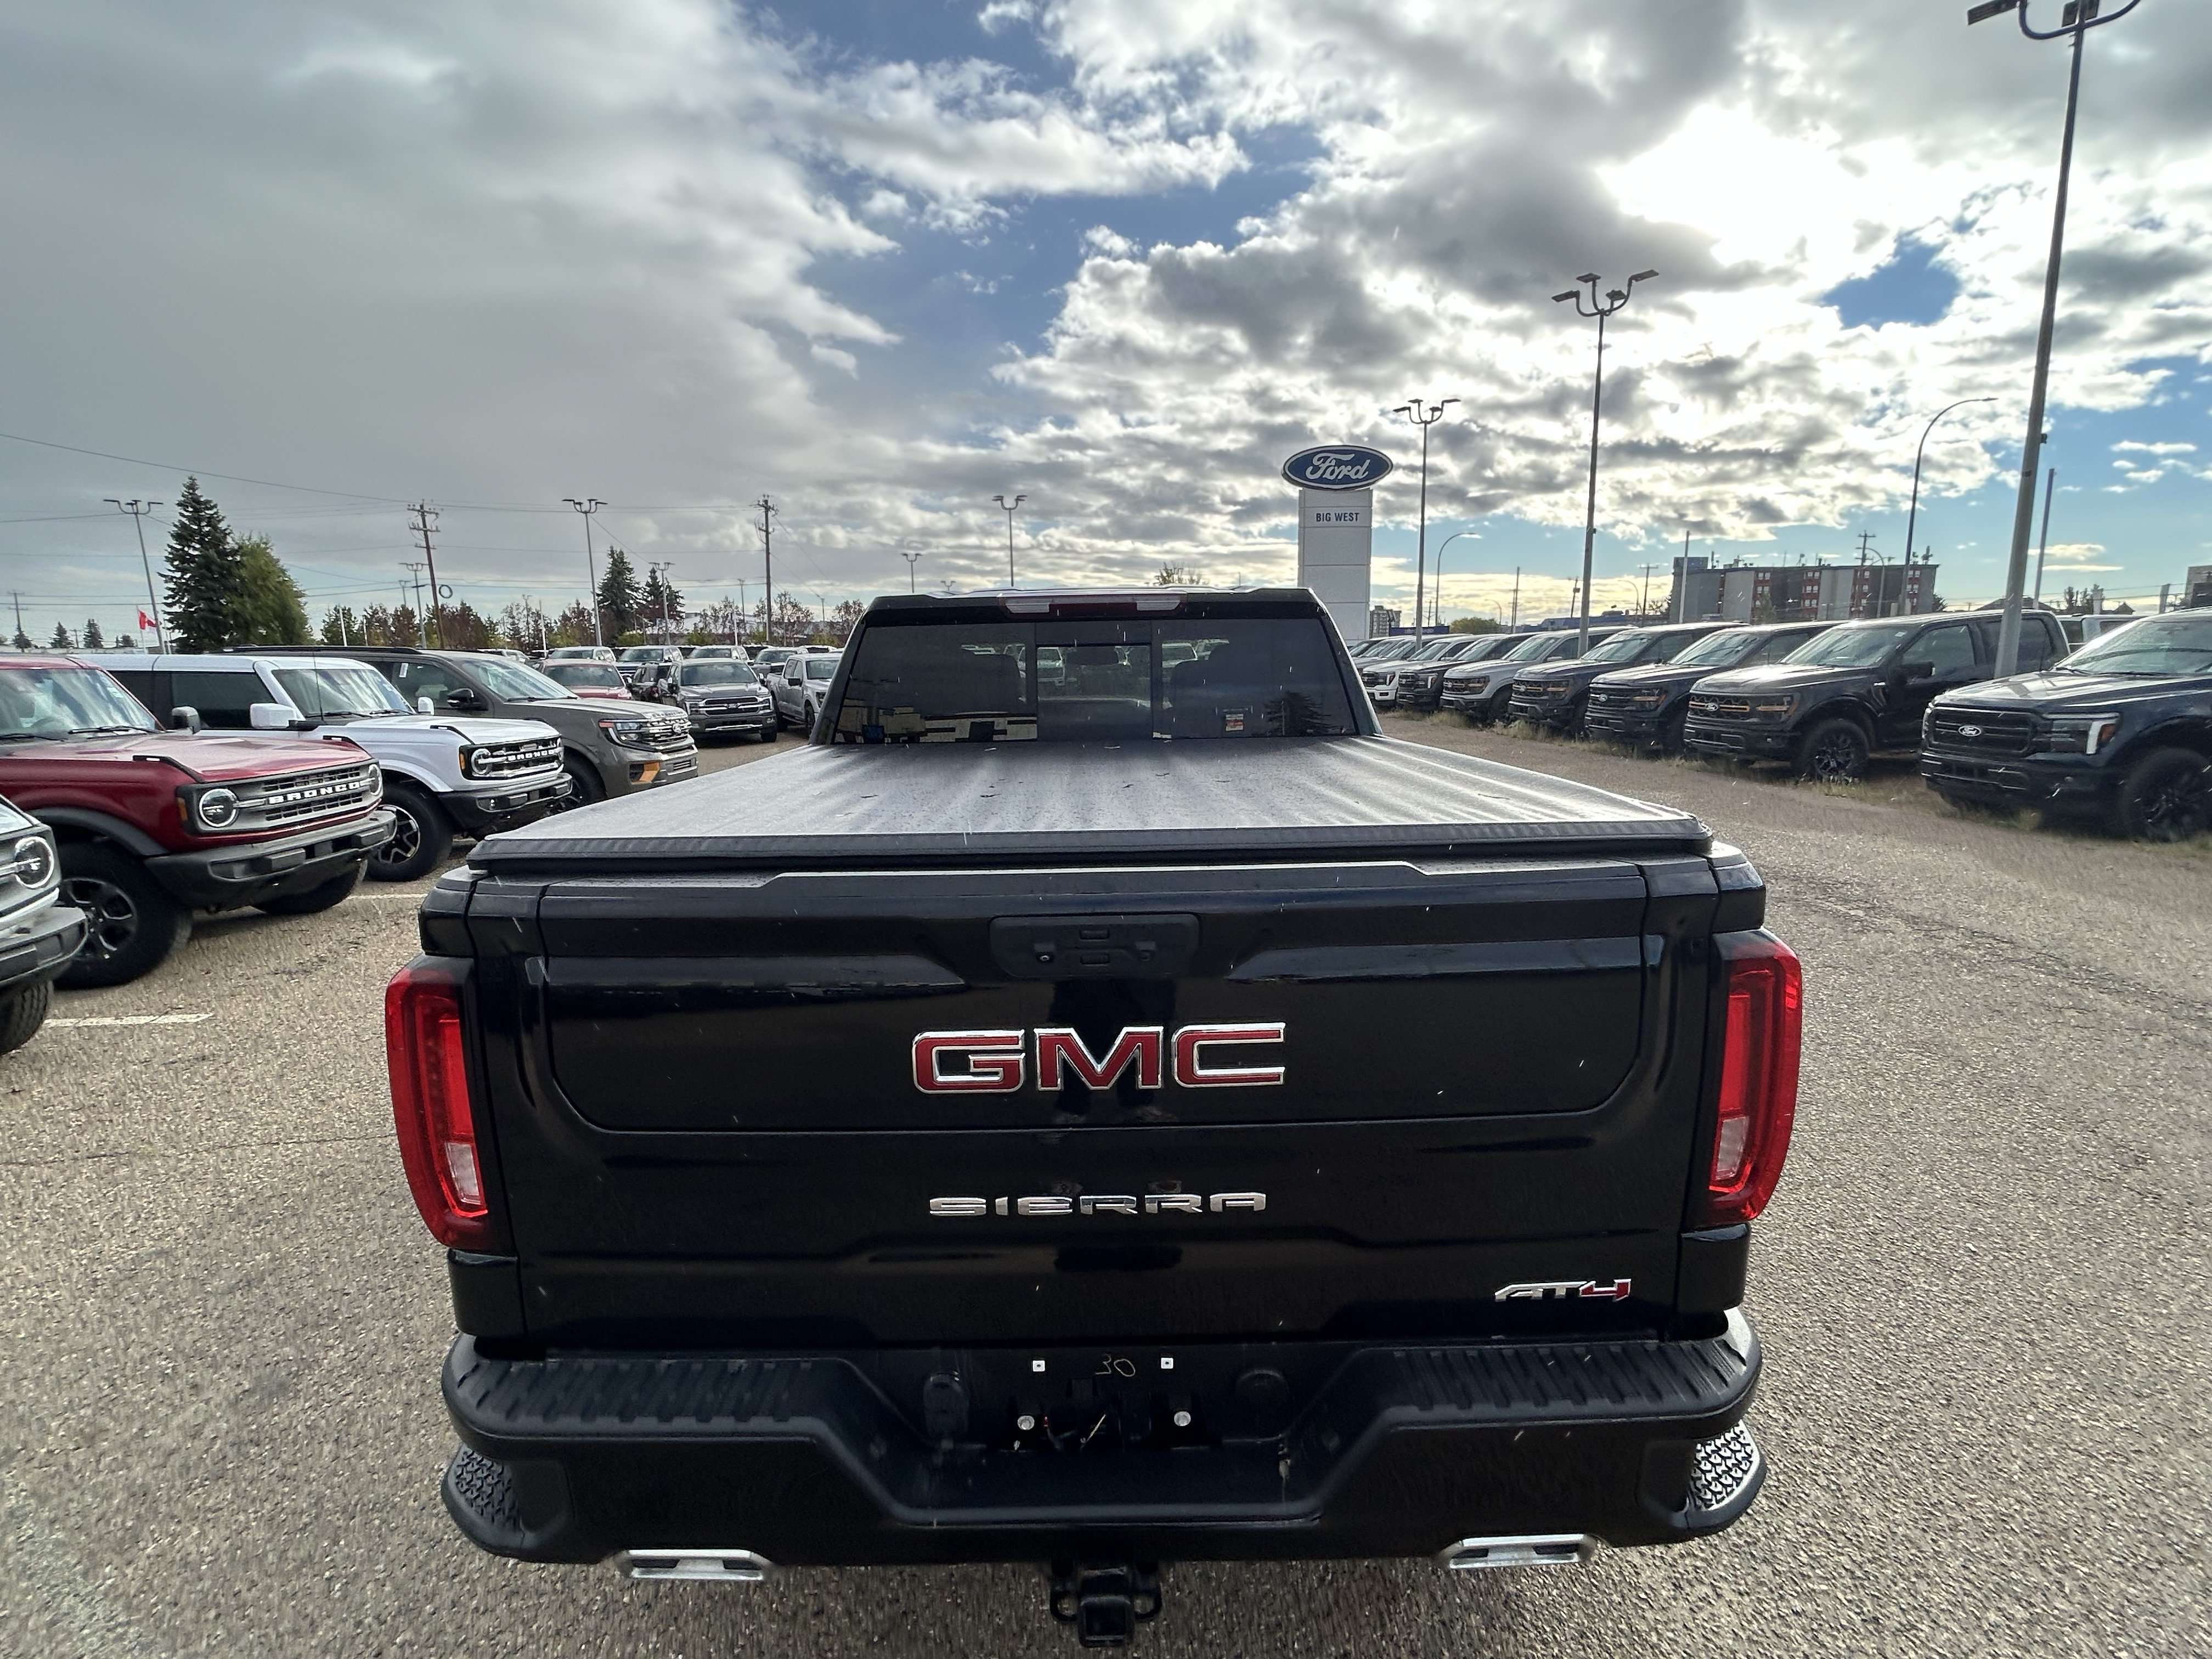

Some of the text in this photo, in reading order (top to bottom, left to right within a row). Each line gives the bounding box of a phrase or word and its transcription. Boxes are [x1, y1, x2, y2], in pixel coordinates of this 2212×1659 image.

[1306, 453, 1370, 481] Ford
[1316, 512, 1360, 522] BIG WEST
[507, 749, 555, 761] BRONCO
[268, 781, 360, 805] BRONCO
[912, 1022, 1286, 1093] GMC
[930, 1193, 1266, 1216] SIERRA
[1494, 1278, 1632, 1302] AT4
[1095, 1353, 1136, 1377] 30
